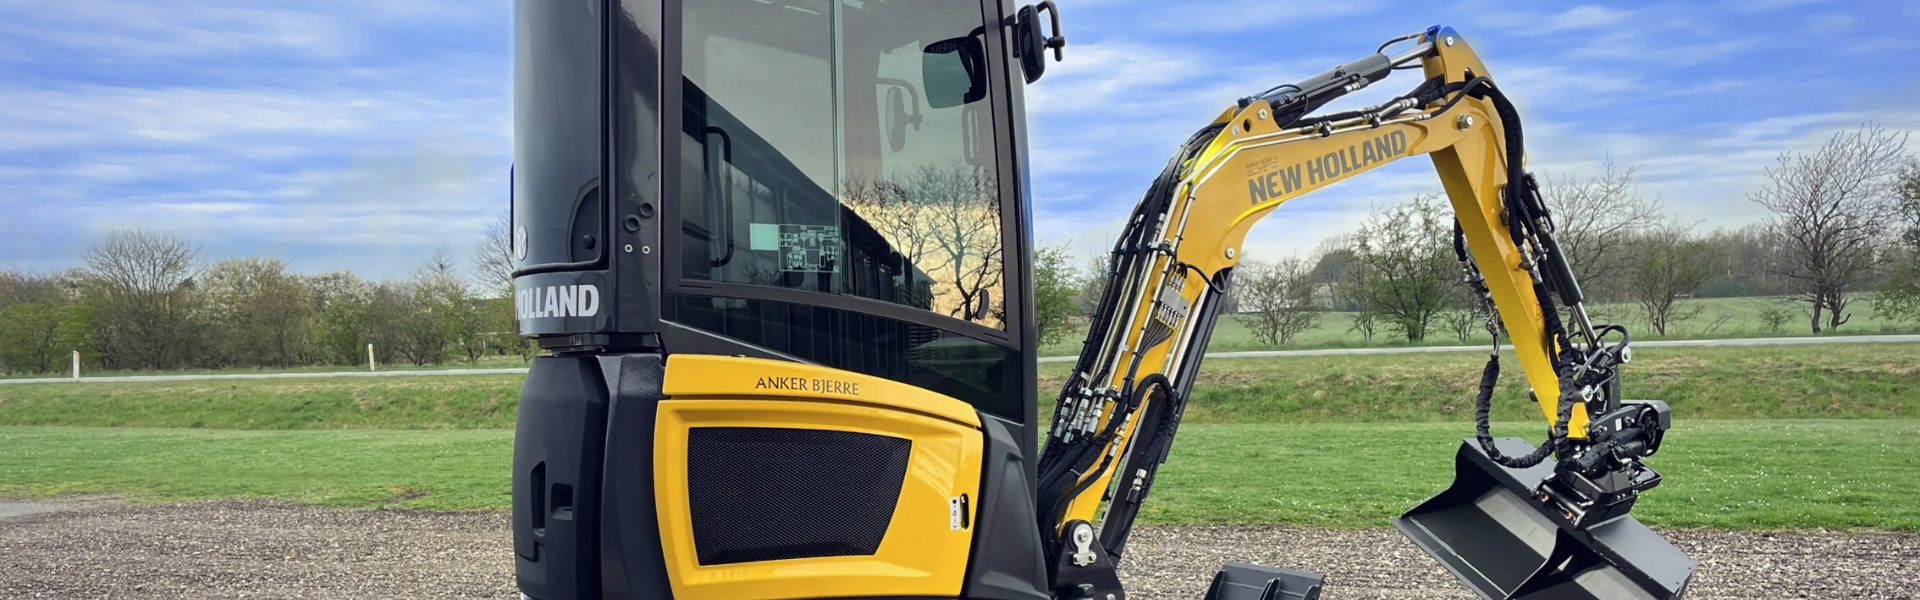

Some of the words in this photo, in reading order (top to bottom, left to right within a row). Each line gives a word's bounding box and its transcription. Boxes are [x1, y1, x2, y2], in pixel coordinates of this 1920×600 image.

[1248, 163, 1302, 205] NEW
[1306, 129, 1408, 185] HOLLAND
[755, 376, 808, 390] ANKER
[812, 379, 860, 395] BJERRE
